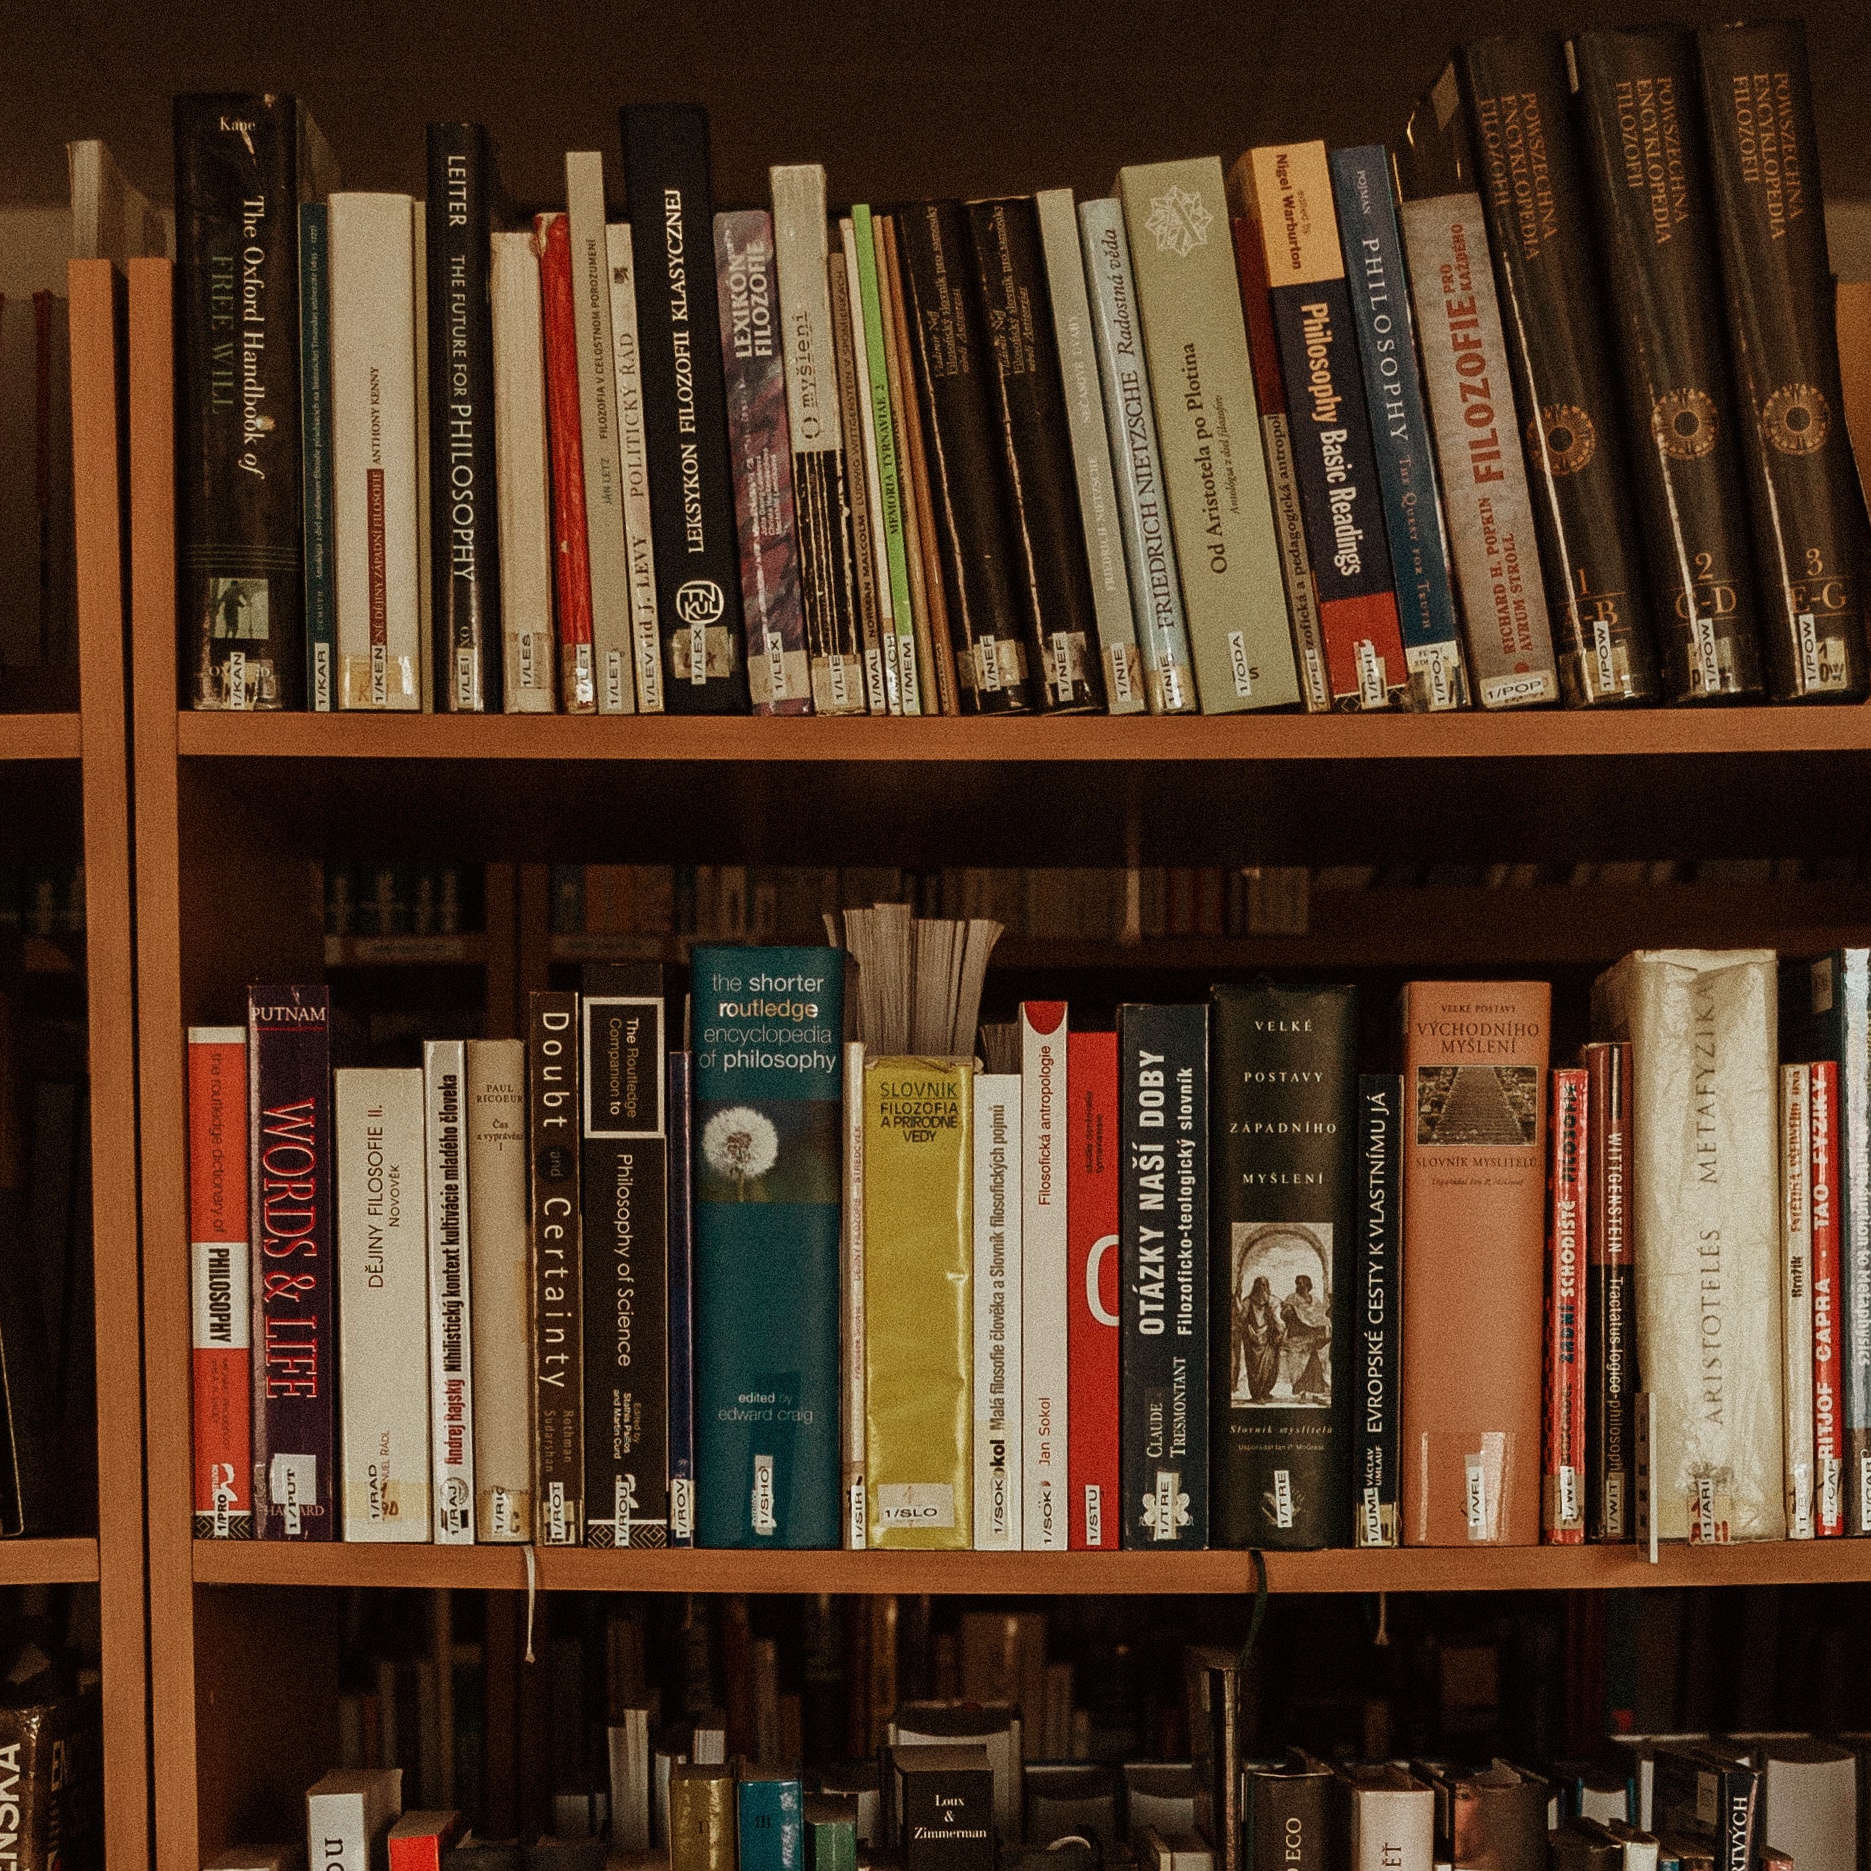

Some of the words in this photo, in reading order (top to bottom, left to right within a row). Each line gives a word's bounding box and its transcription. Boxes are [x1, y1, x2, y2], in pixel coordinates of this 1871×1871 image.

[243, 195, 264, 238] The
[447, 155, 465, 227] LEITER
[243, 246, 264, 322] Oxford
[665, 189, 687, 322] KLASYCZNEJ
[1301, 302, 1339, 421] Philosophy
[1366, 238, 1407, 442] PHILOSOPHY
[243, 331, 268, 445] Handbook
[370, 366, 379, 402] KENNY
[674, 332, 695, 435] FILOZOFII
[371, 407, 381, 464] ANTHONY
[1321, 428, 1348, 485] Basic
[242, 453, 265, 479] of
[682, 445, 704, 554] LEKSYKON
[1330, 488, 1362, 577] Readings
[315, 648, 328, 711] 1/KAR
[1485, 681, 1542, 703] 1/POP
[712, 974, 743, 991] the
[750, 974, 824, 993] shorter
[719, 1000, 818, 1022] routledge
[251, 1005, 326, 1024] PUTNAM
[704, 1025, 831, 1047] encyclopedia
[1255, 1019, 1313, 1031] VELKÉ
[542, 1012, 570, 1128] Doubt
[699, 1050, 718, 1069] of
[723, 1050, 836, 1073] philosophy
[1139, 1050, 1165, 1127] DOBY
[1243, 1072, 1323, 1082] POSTAVY
[1230, 1121, 1337, 1133] ZÁPADNÍHO
[263, 1098, 319, 1265] WORDS
[549, 1150, 562, 1178] and
[1138, 1144, 1163, 1211] NAŠÍ
[1242, 1172, 1323, 1185] MYŠLENÍ
[263, 1271, 316, 1308] &
[540, 1196, 571, 1391] Certainty
[1137, 1227, 1163, 1335] OTÁZKY
[266, 1315, 313, 1401] LIFE
[885, 1508, 938, 1518] 1/SLO
[1285, 1817, 1301, 1861] ECO
